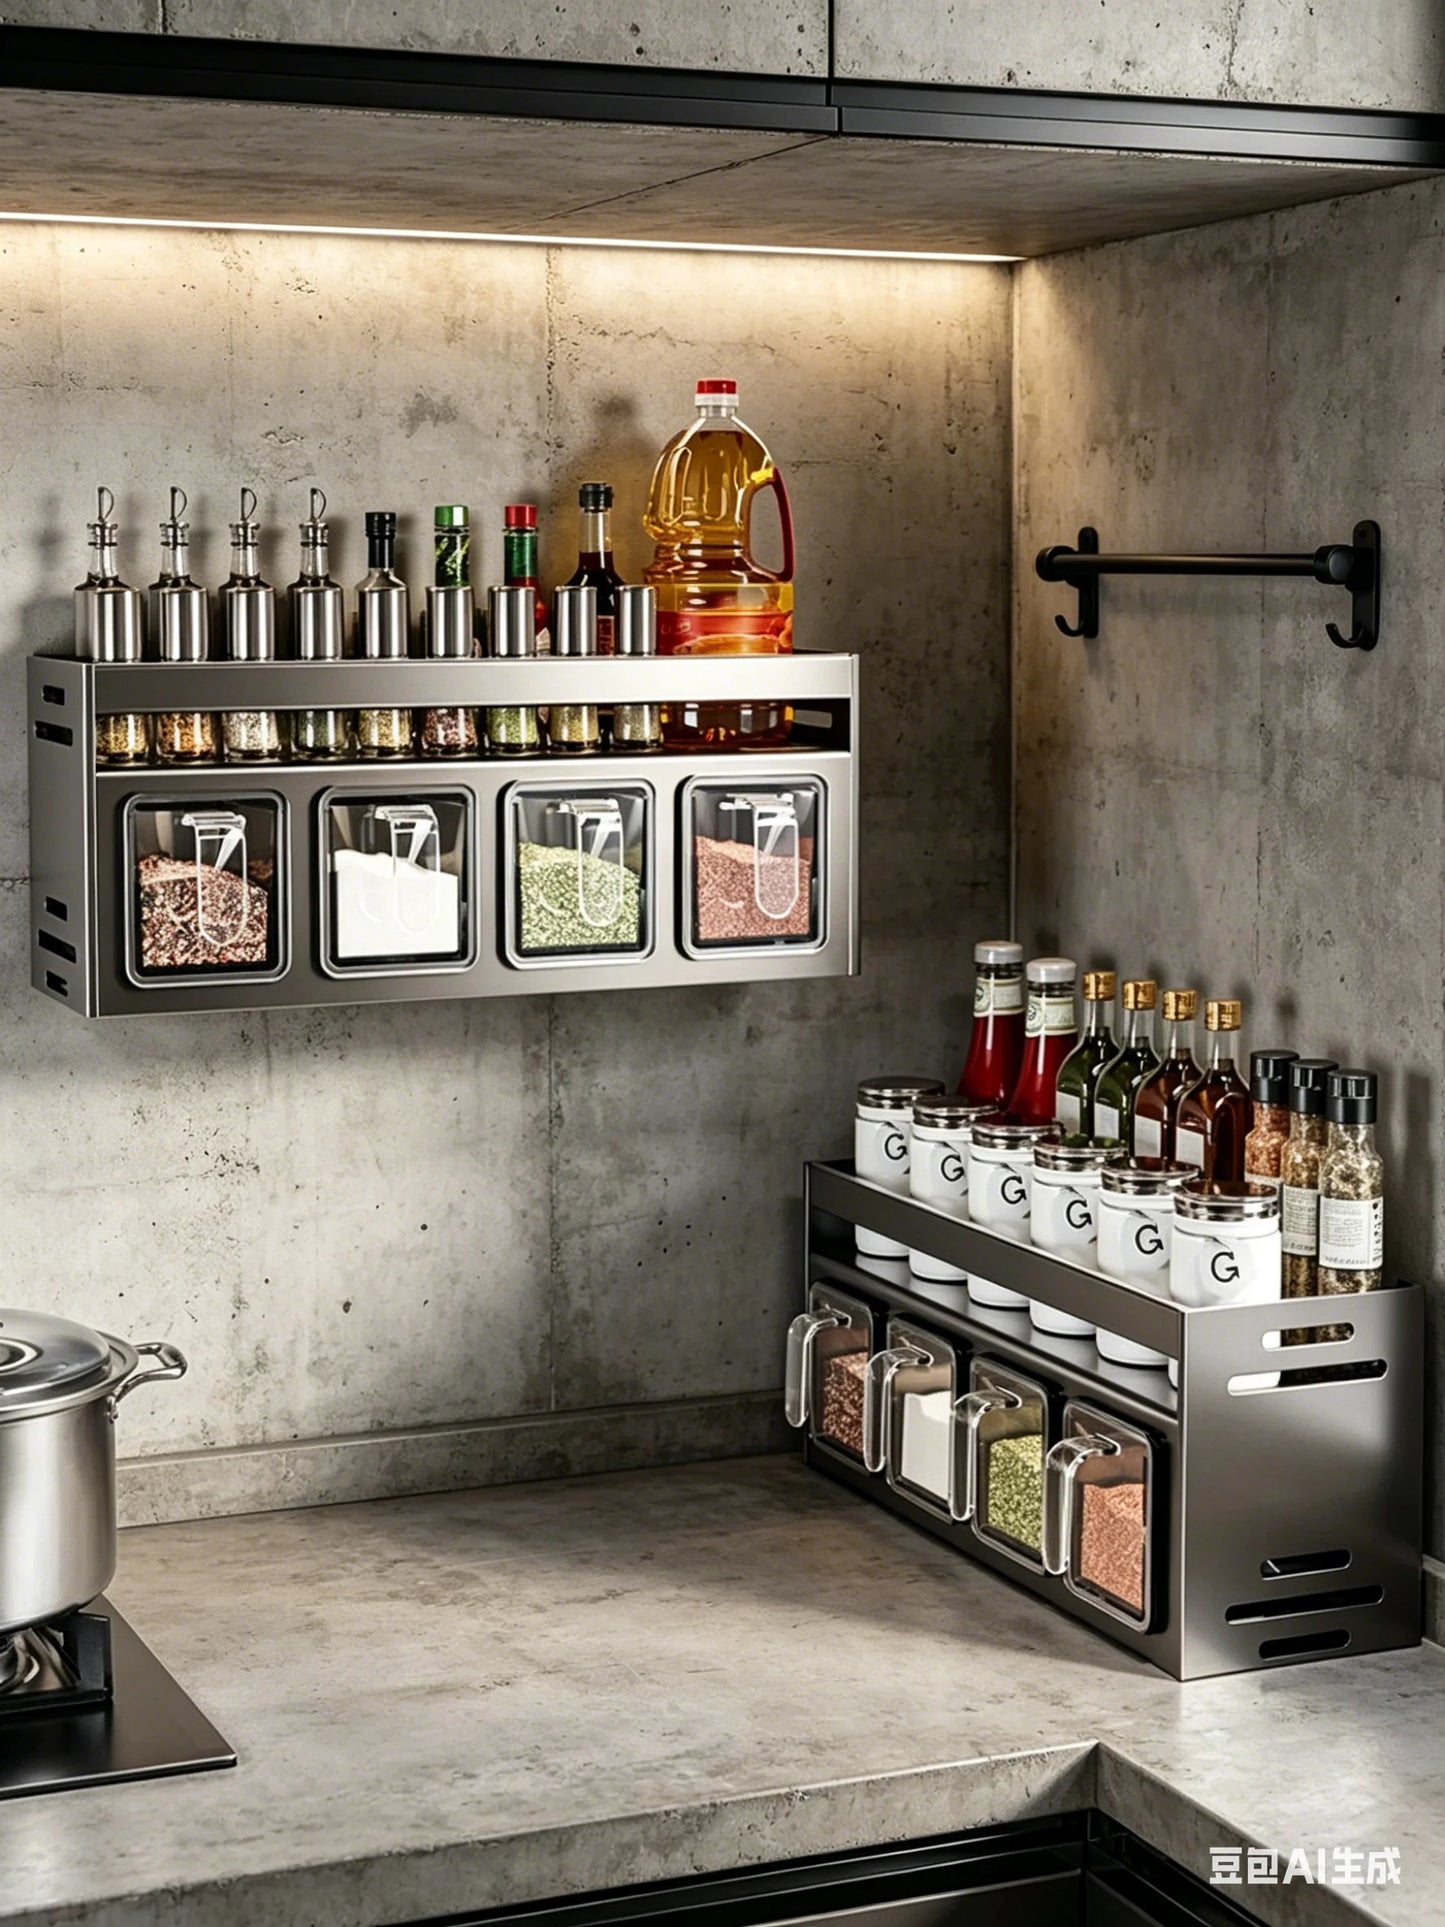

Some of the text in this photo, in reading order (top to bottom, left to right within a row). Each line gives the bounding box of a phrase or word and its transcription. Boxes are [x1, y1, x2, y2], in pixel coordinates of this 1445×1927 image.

[884, 1133, 908, 1161] G
[940, 1154, 965, 1182] G
[1000, 1176, 1028, 1205] G
[1065, 1200, 1093, 1230] G
[1134, 1225, 1164, 1255] G
[1210, 1252, 1240, 1283] G
